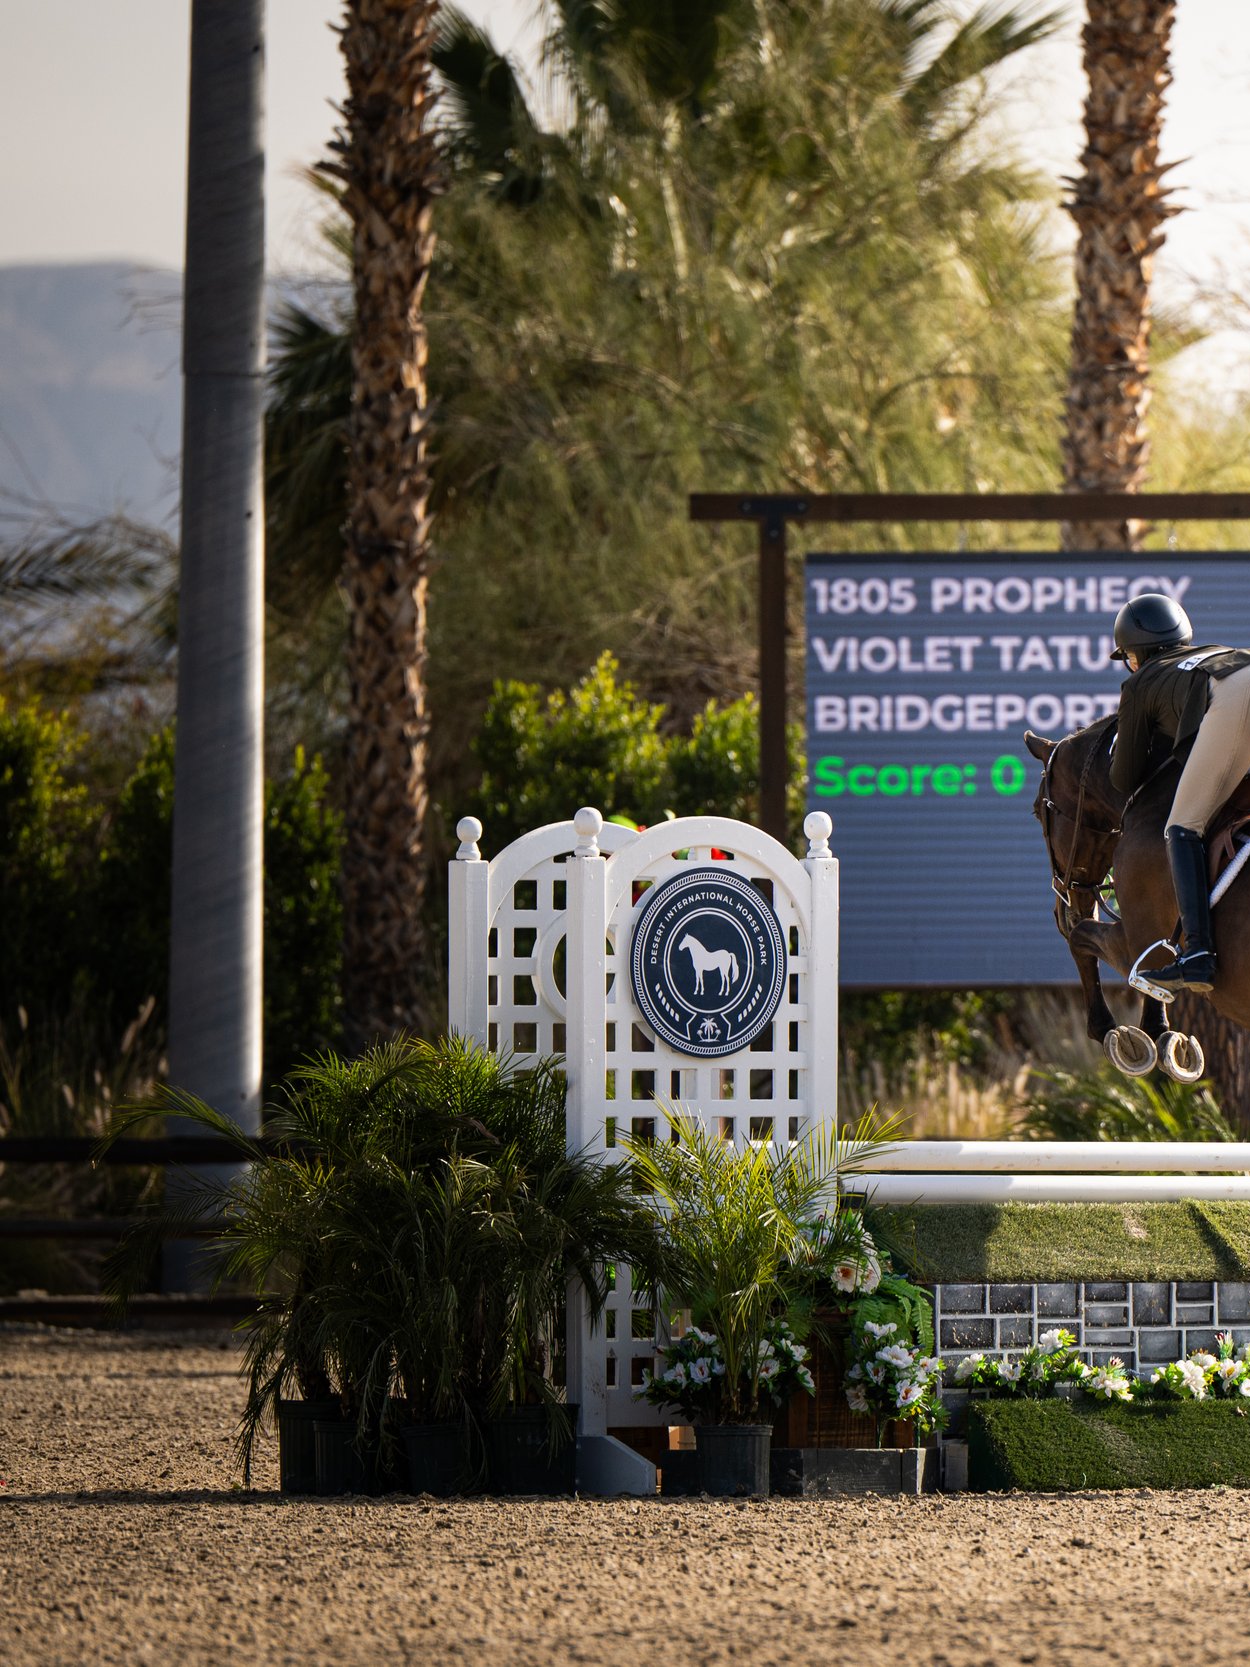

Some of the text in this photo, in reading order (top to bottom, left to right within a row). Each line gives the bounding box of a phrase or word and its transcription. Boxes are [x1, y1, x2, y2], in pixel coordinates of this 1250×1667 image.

[811, 578, 917, 614] 1805
[811, 635, 1123, 673] VIOLET TATU
[814, 754, 1026, 797] Score: 0
[651, 891, 767, 965] DESERT INTERNATIONAL HORSE PARK
